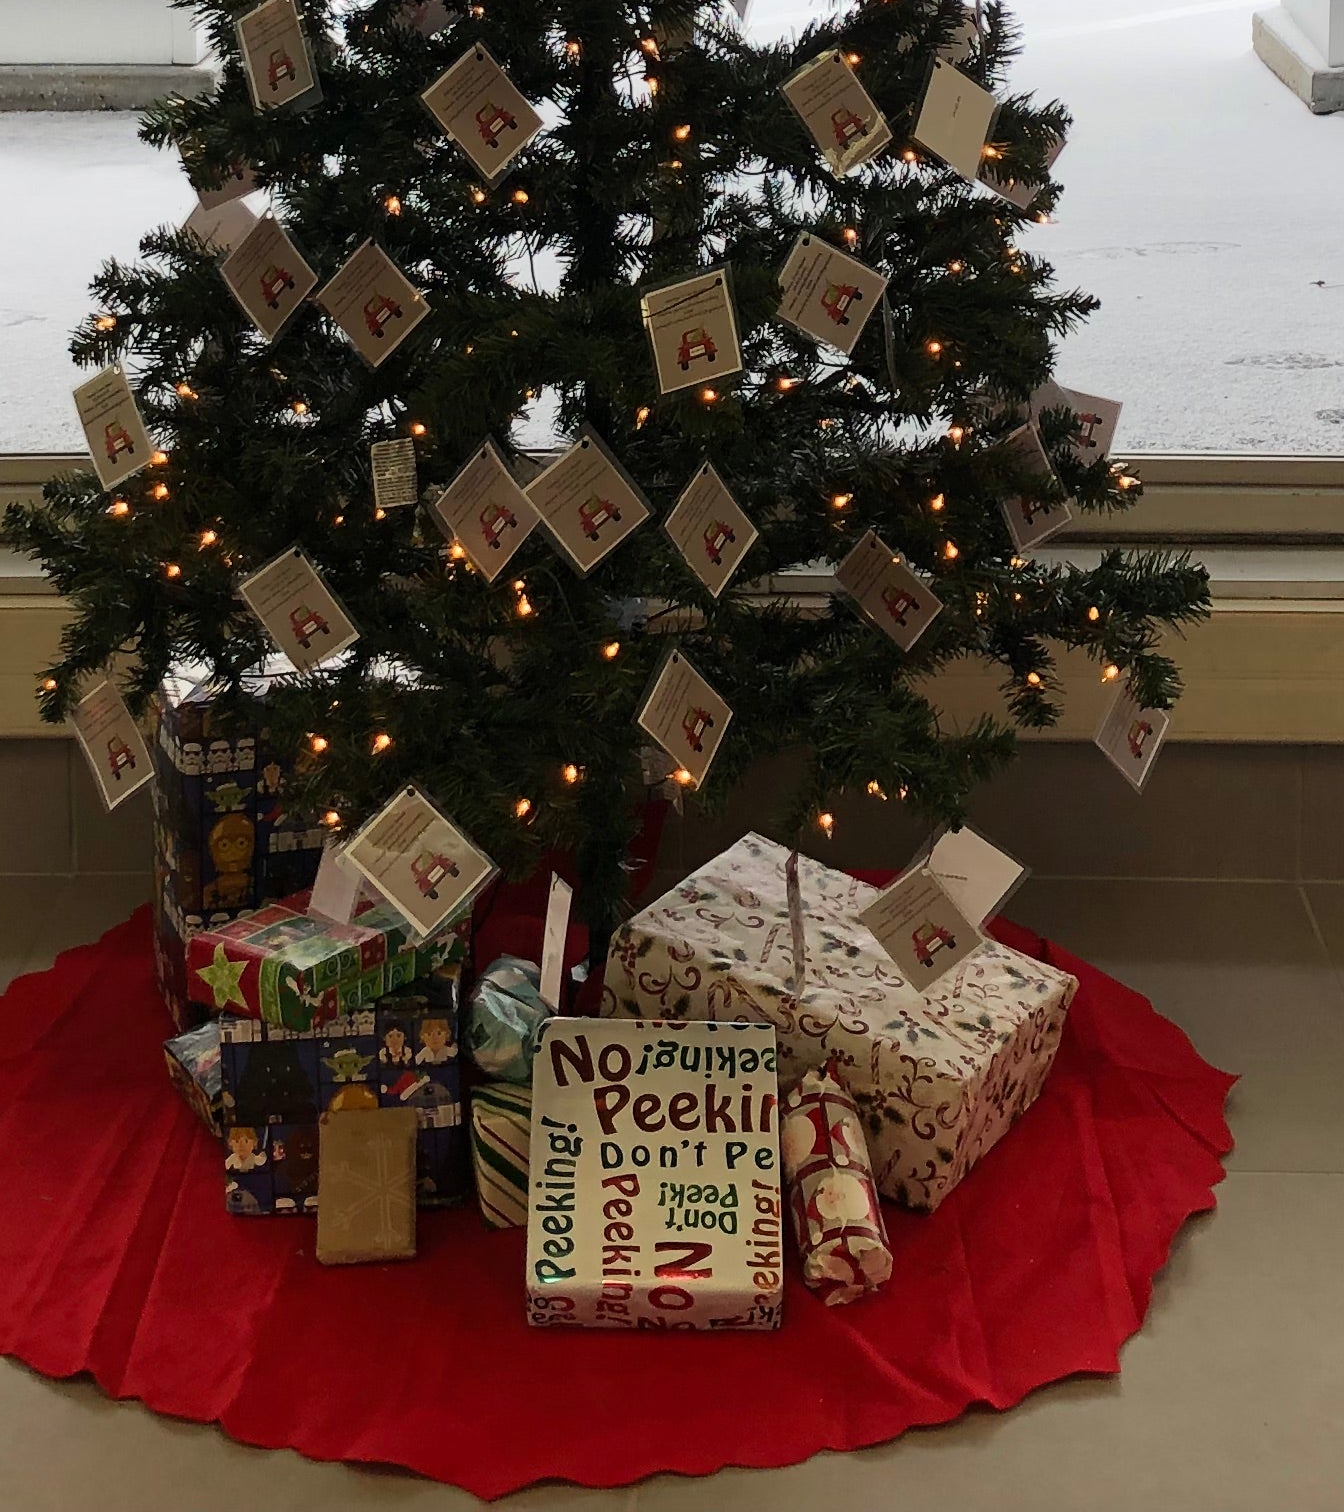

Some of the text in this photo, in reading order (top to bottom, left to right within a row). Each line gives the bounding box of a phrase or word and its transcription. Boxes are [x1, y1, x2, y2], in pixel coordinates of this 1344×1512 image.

[549, 1034, 632, 1087] No
[600, 1140, 707, 1170] Don't
[535, 1115, 584, 1284] Peeking!
[657, 1181, 739, 1208] Peek!
[664, 1207, 738, 1235] Don't
[596, 1173, 641, 1326] Peeking!
[648, 1241, 713, 1311] No
